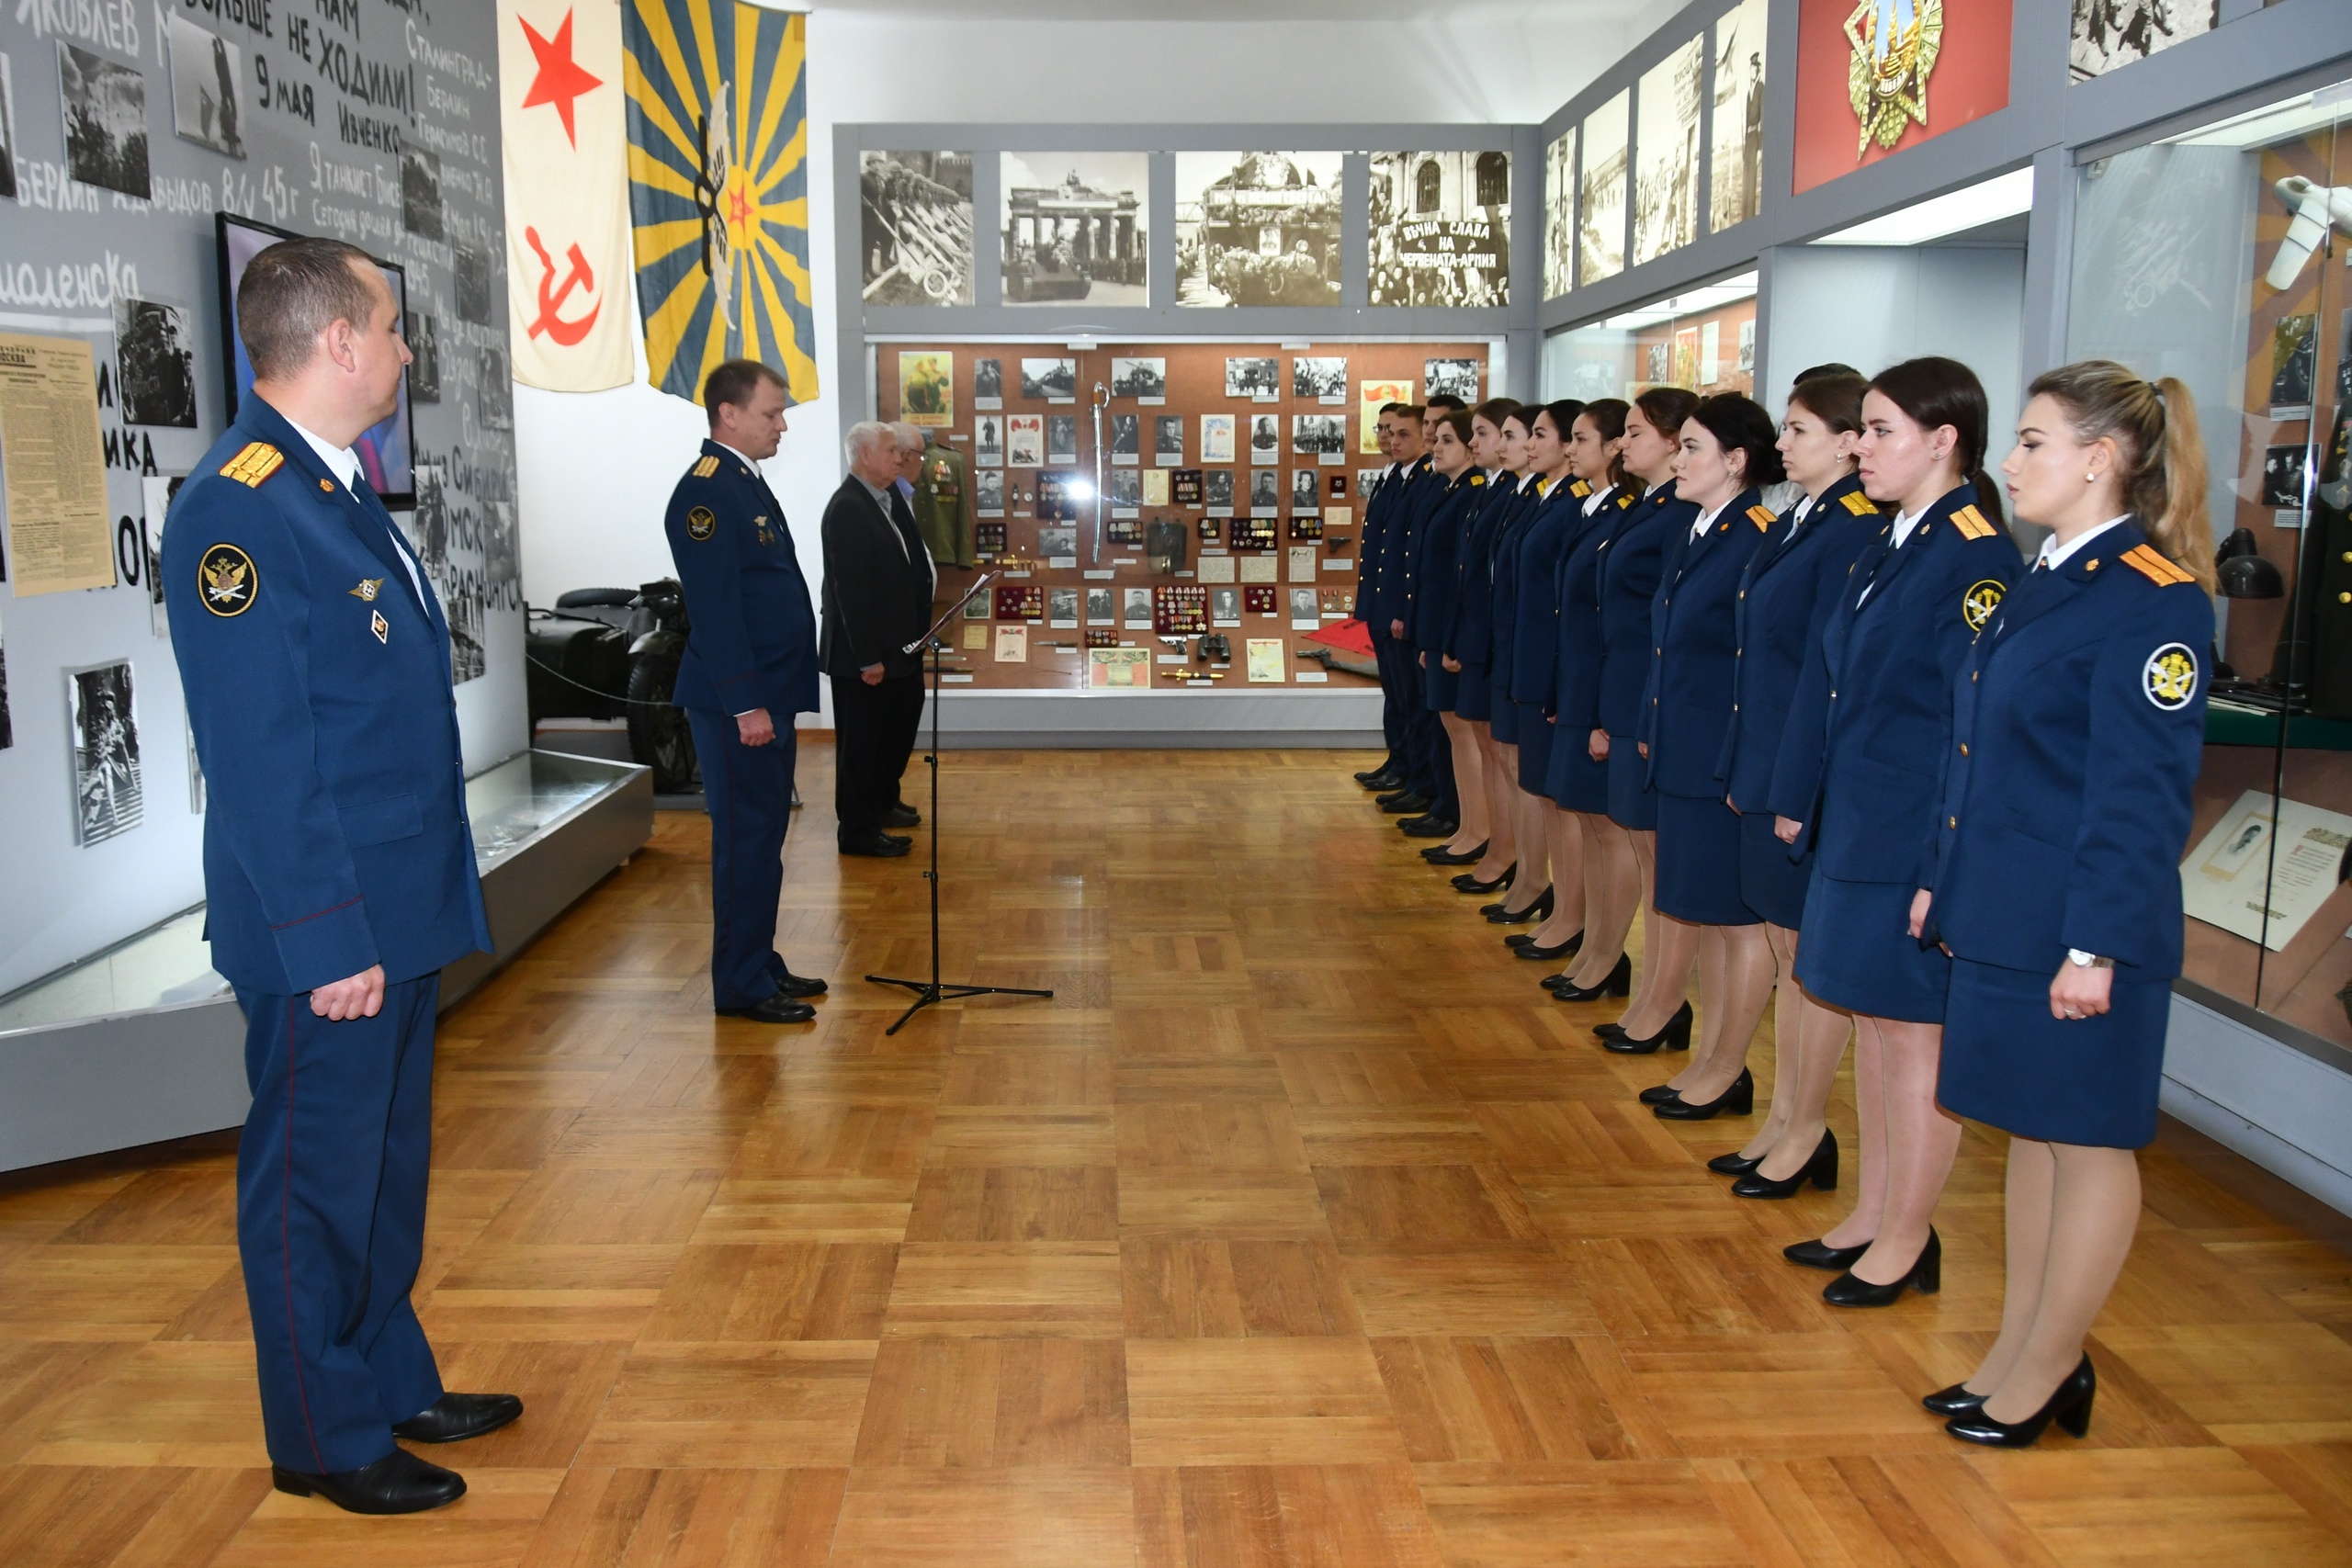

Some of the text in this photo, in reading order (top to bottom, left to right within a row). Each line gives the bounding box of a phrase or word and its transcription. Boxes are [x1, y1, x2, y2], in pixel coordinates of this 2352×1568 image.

[254, 53, 315, 127] 9 МАЯ
[288, 12, 416, 129] НЕ ХОДИЛИ!
[1439, 236, 1455, 251] НА
[1449, 221, 1490, 240] СЛАВА
